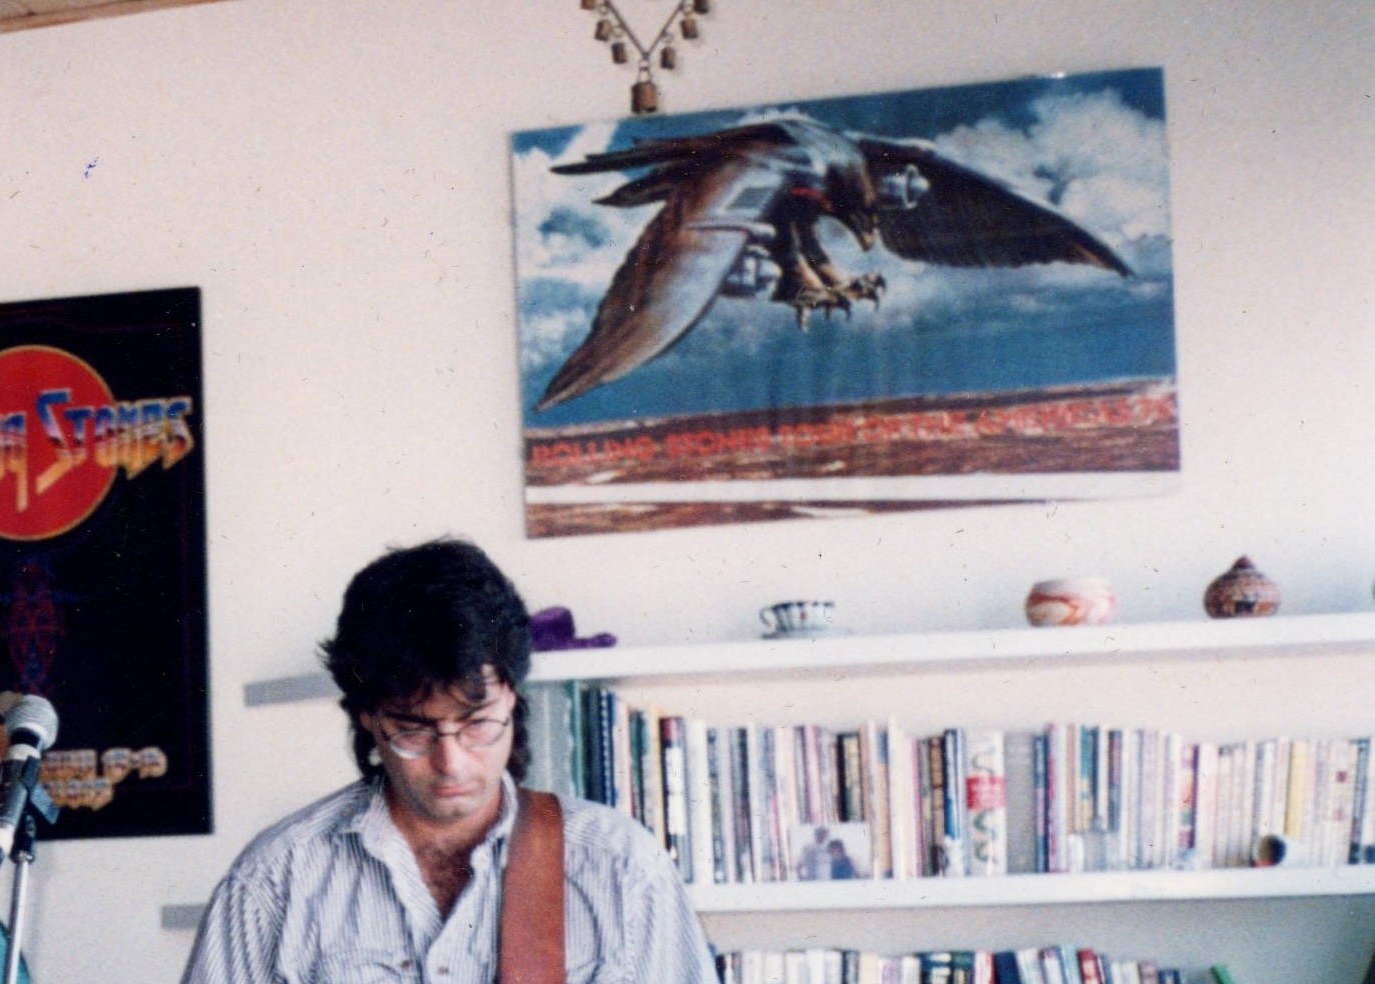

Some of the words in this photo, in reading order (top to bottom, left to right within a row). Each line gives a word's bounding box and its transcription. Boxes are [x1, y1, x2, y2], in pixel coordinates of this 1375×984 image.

[532, 436, 655, 467] ROLLING
[666, 427, 771, 457] STONES
[779, 419, 857, 451] TOUR
